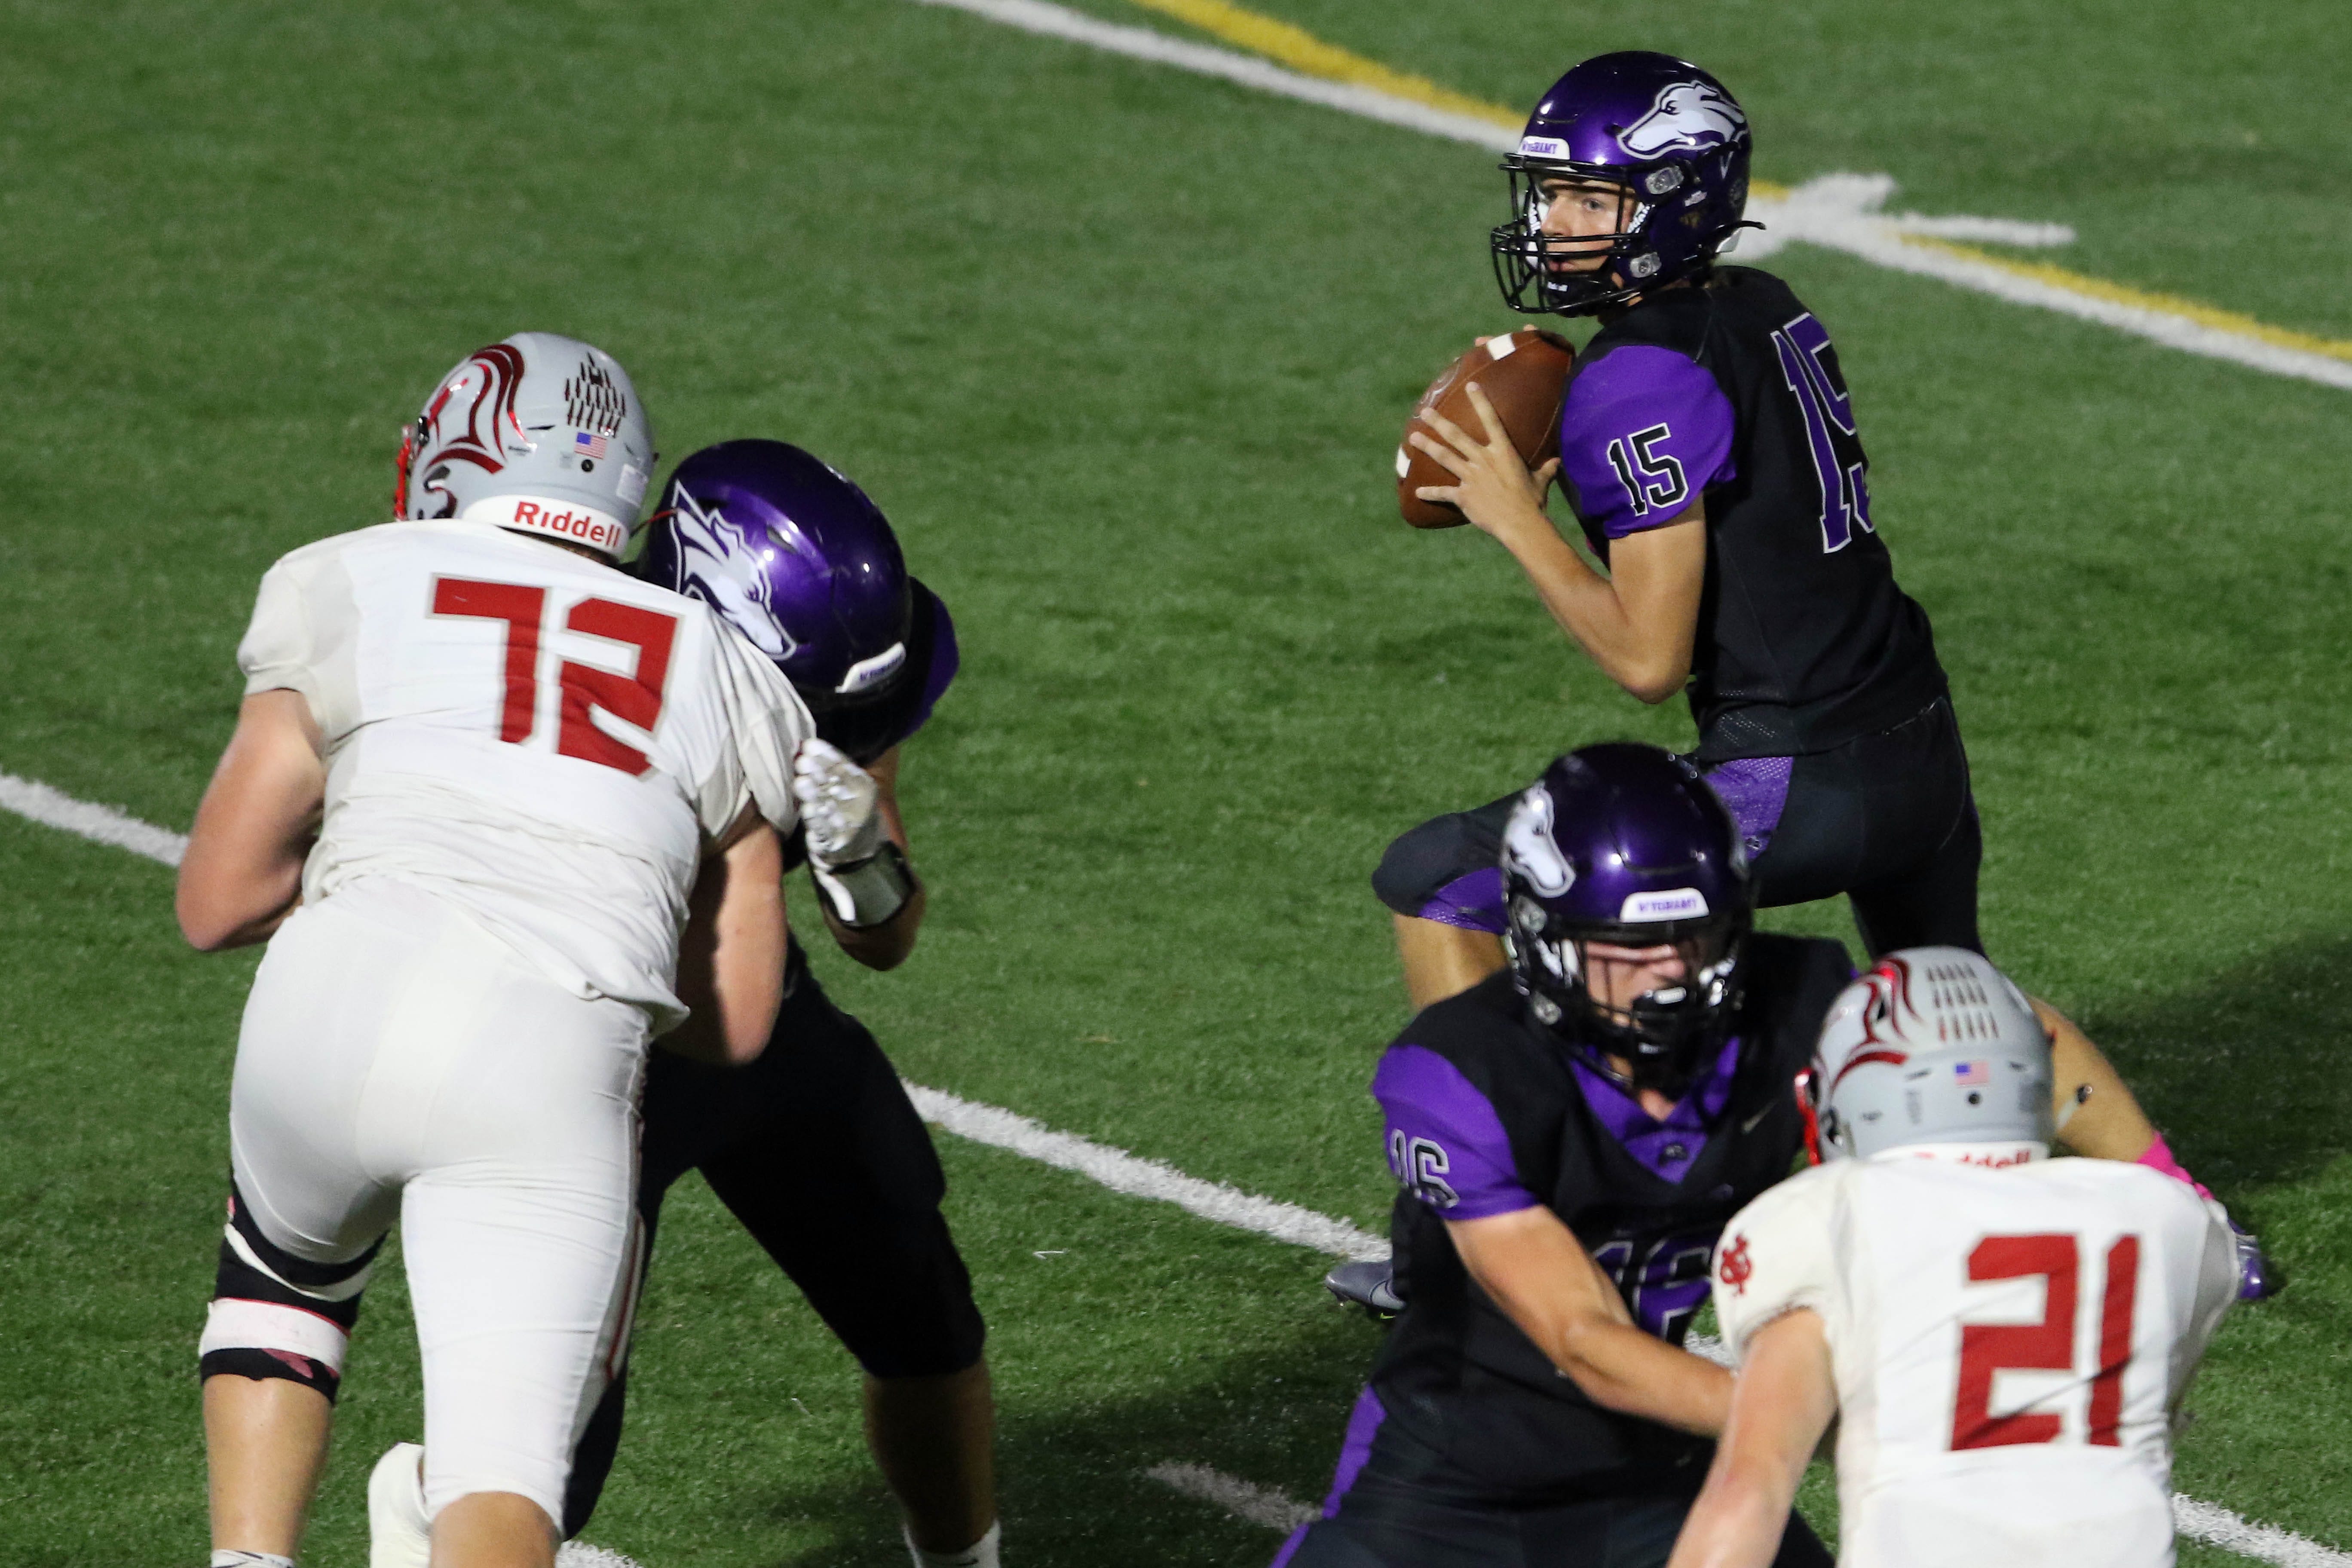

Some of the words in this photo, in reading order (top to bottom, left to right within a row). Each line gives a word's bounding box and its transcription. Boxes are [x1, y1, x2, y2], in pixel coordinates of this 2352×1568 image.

[514, 500, 622, 548] Riddell
[1608, 423, 1689, 517] 15
[429, 573, 683, 776] 72
[1947, 1231, 2141, 1452] 21
